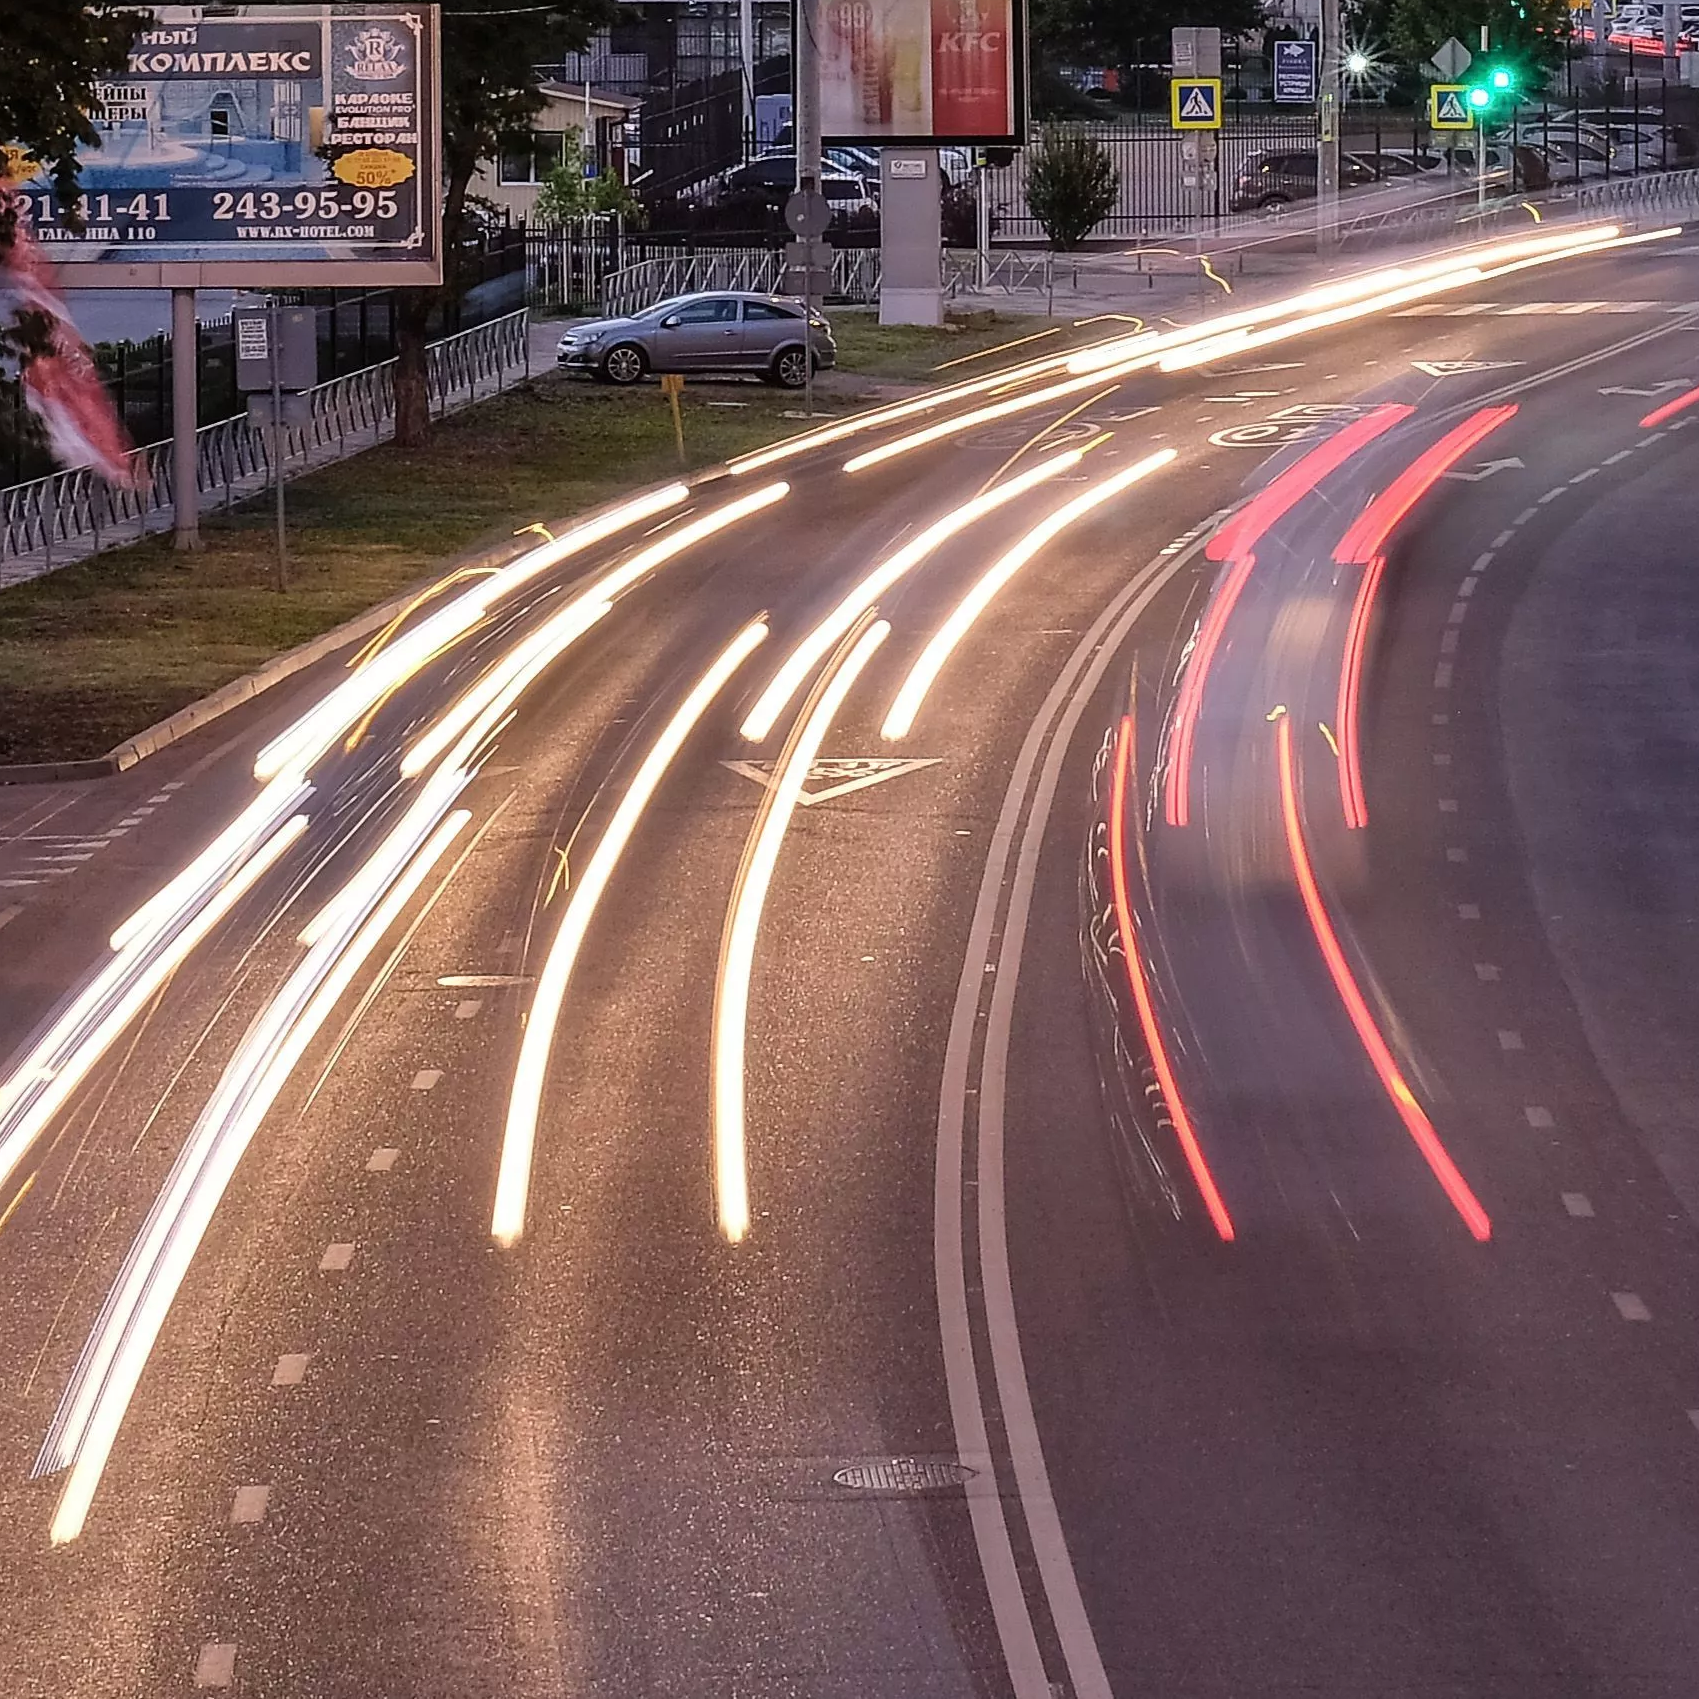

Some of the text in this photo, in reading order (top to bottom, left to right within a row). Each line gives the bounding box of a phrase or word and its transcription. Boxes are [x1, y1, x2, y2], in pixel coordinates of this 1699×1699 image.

[369, 41, 382, 55] R
[937, 31, 1001, 53] KFC
[127, 50, 312, 74] КОМПЛЕКС
[93, 83, 147, 102] ЕЙНЫ
[334, 92, 414, 105] КАРАОКЕ
[87, 107, 148, 122] ЩЕРЫ
[335, 105, 391, 114] EVOLUTION
[336, 116, 411, 129] БАНЩИК
[331, 132, 418, 145] РЕСТОРАН
[14, 190, 399, 222] 21-41-41 243-95-95
[38, 226, 156, 241] ГАГАИНА 110
